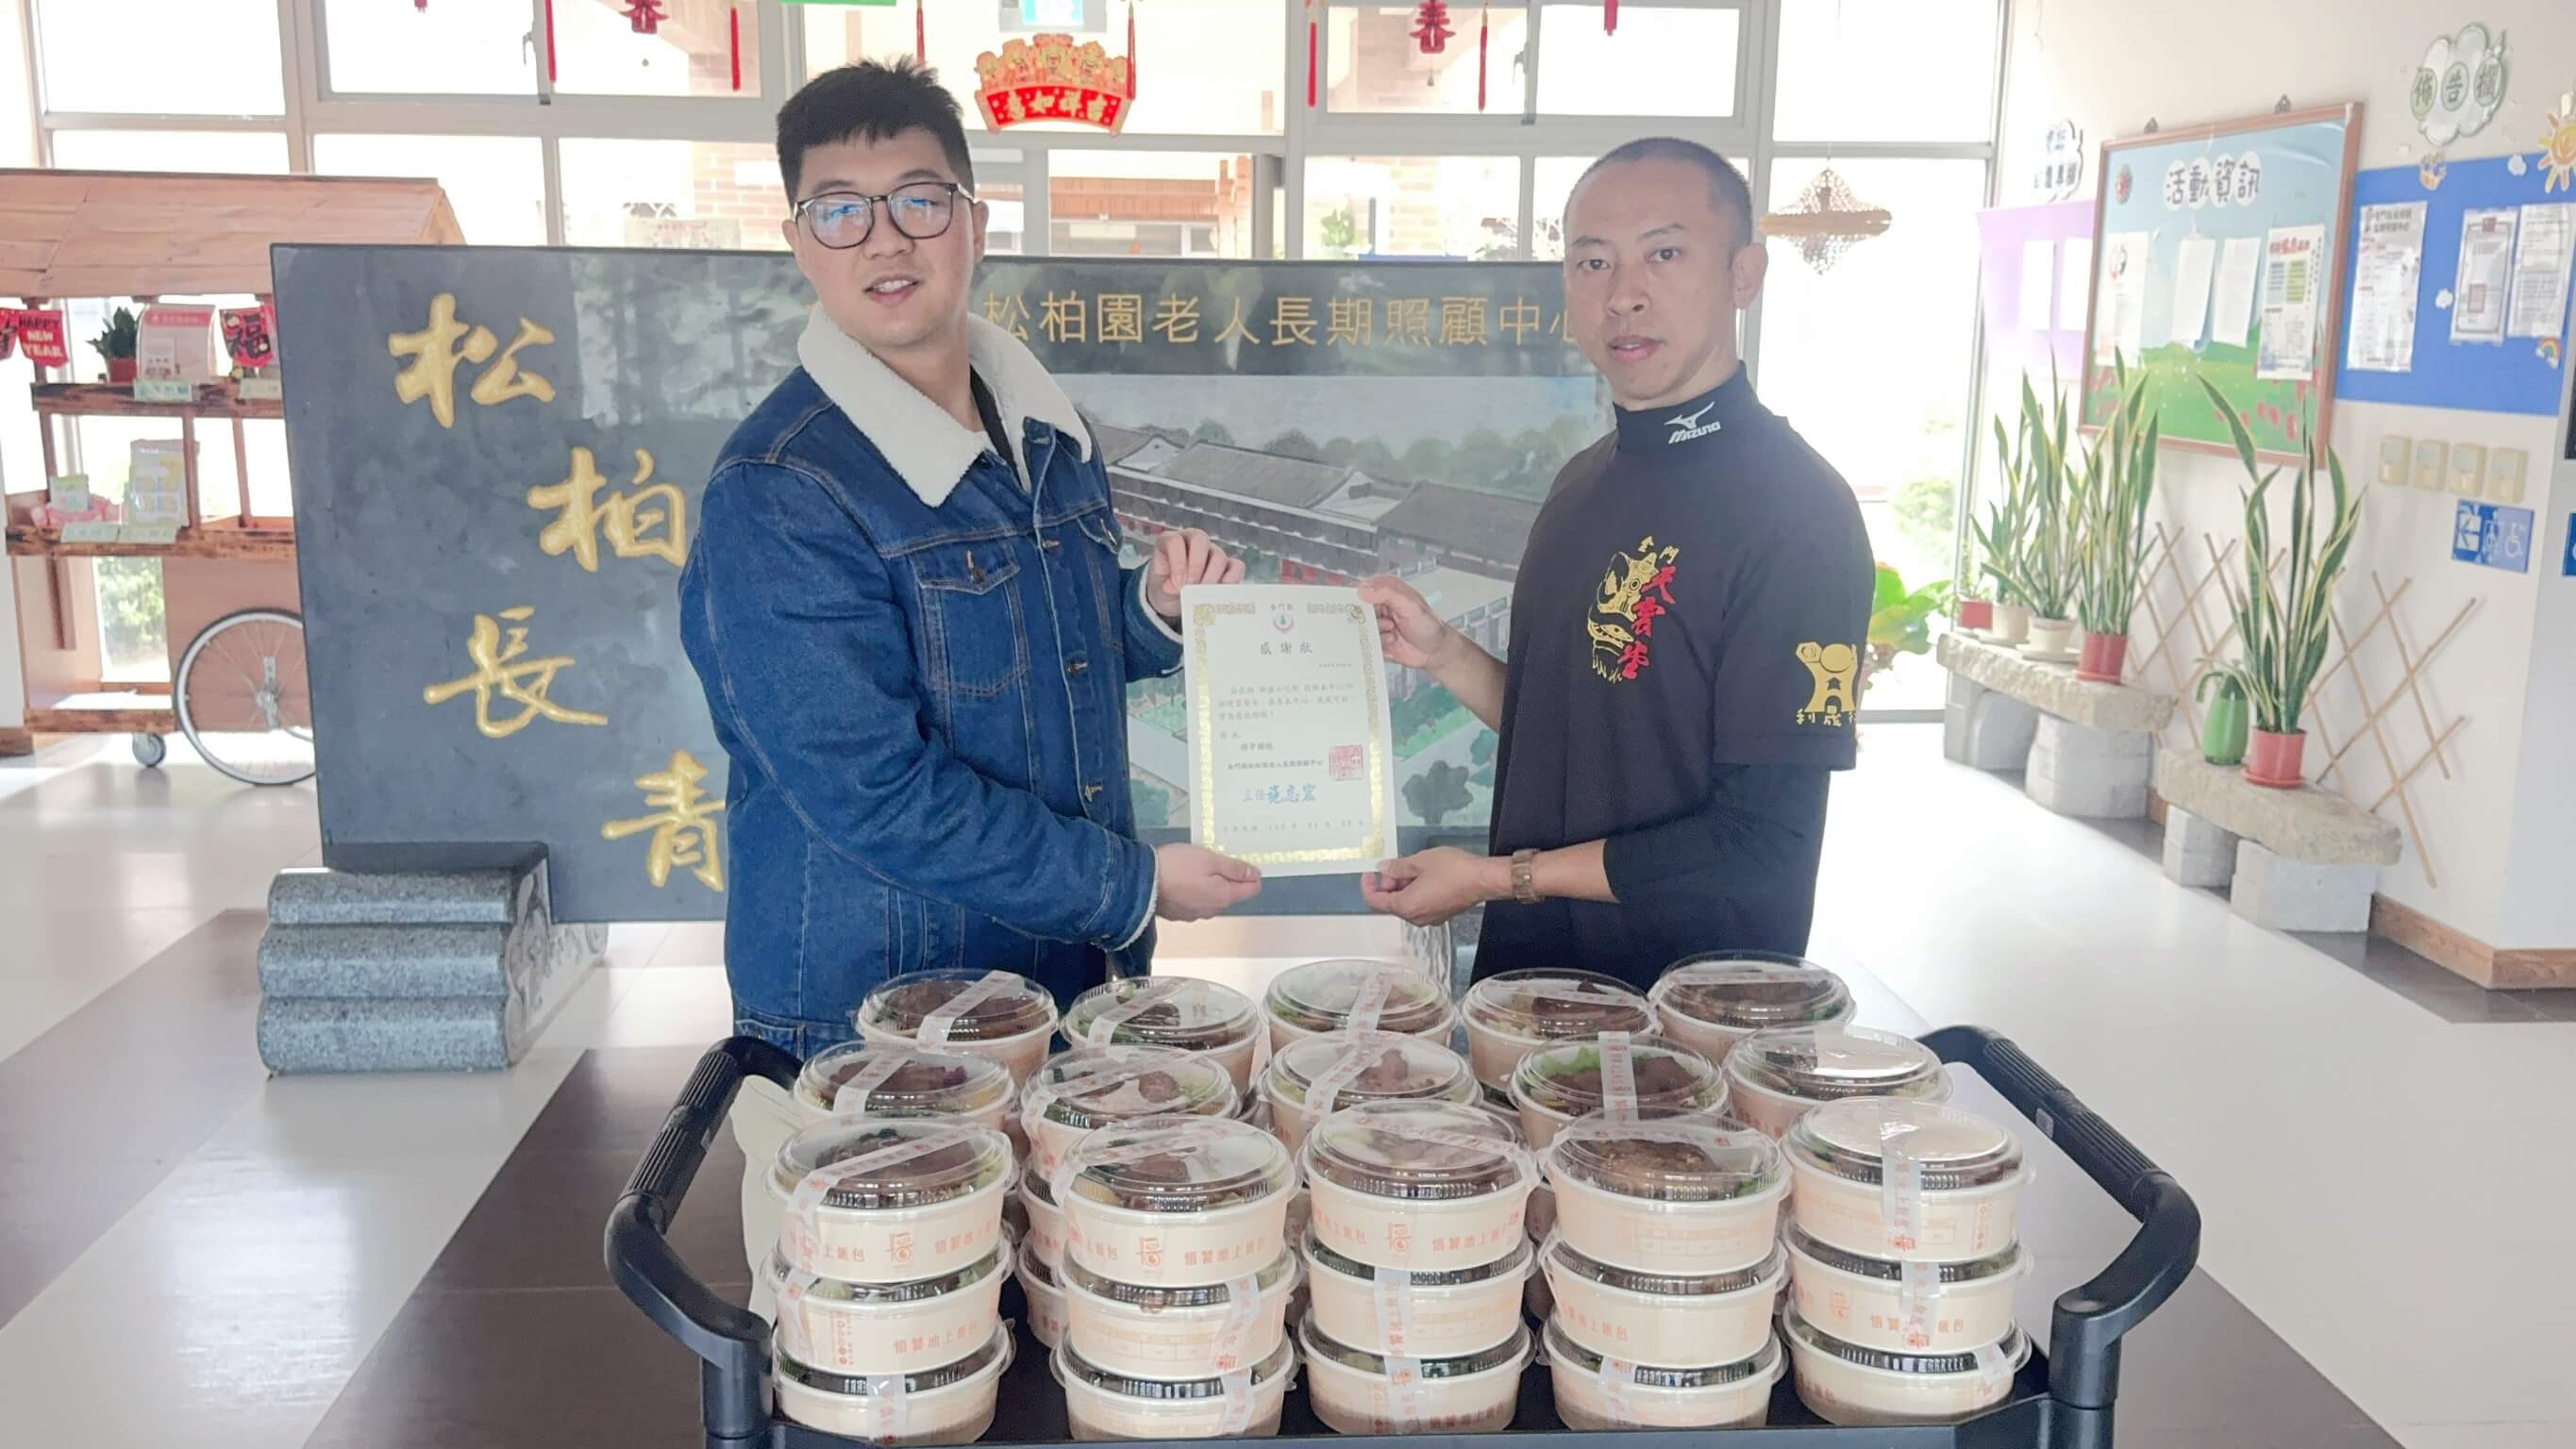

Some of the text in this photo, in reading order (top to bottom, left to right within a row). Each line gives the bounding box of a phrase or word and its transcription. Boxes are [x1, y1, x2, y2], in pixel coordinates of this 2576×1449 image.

[2166, 158, 2260, 205] 活動資訊
[19, 316, 60, 329] HAPPY
[26, 330, 54, 342] NEW
[23, 342, 62, 358] YEAR
[1260, 641, 1313, 656] 感謝狀
